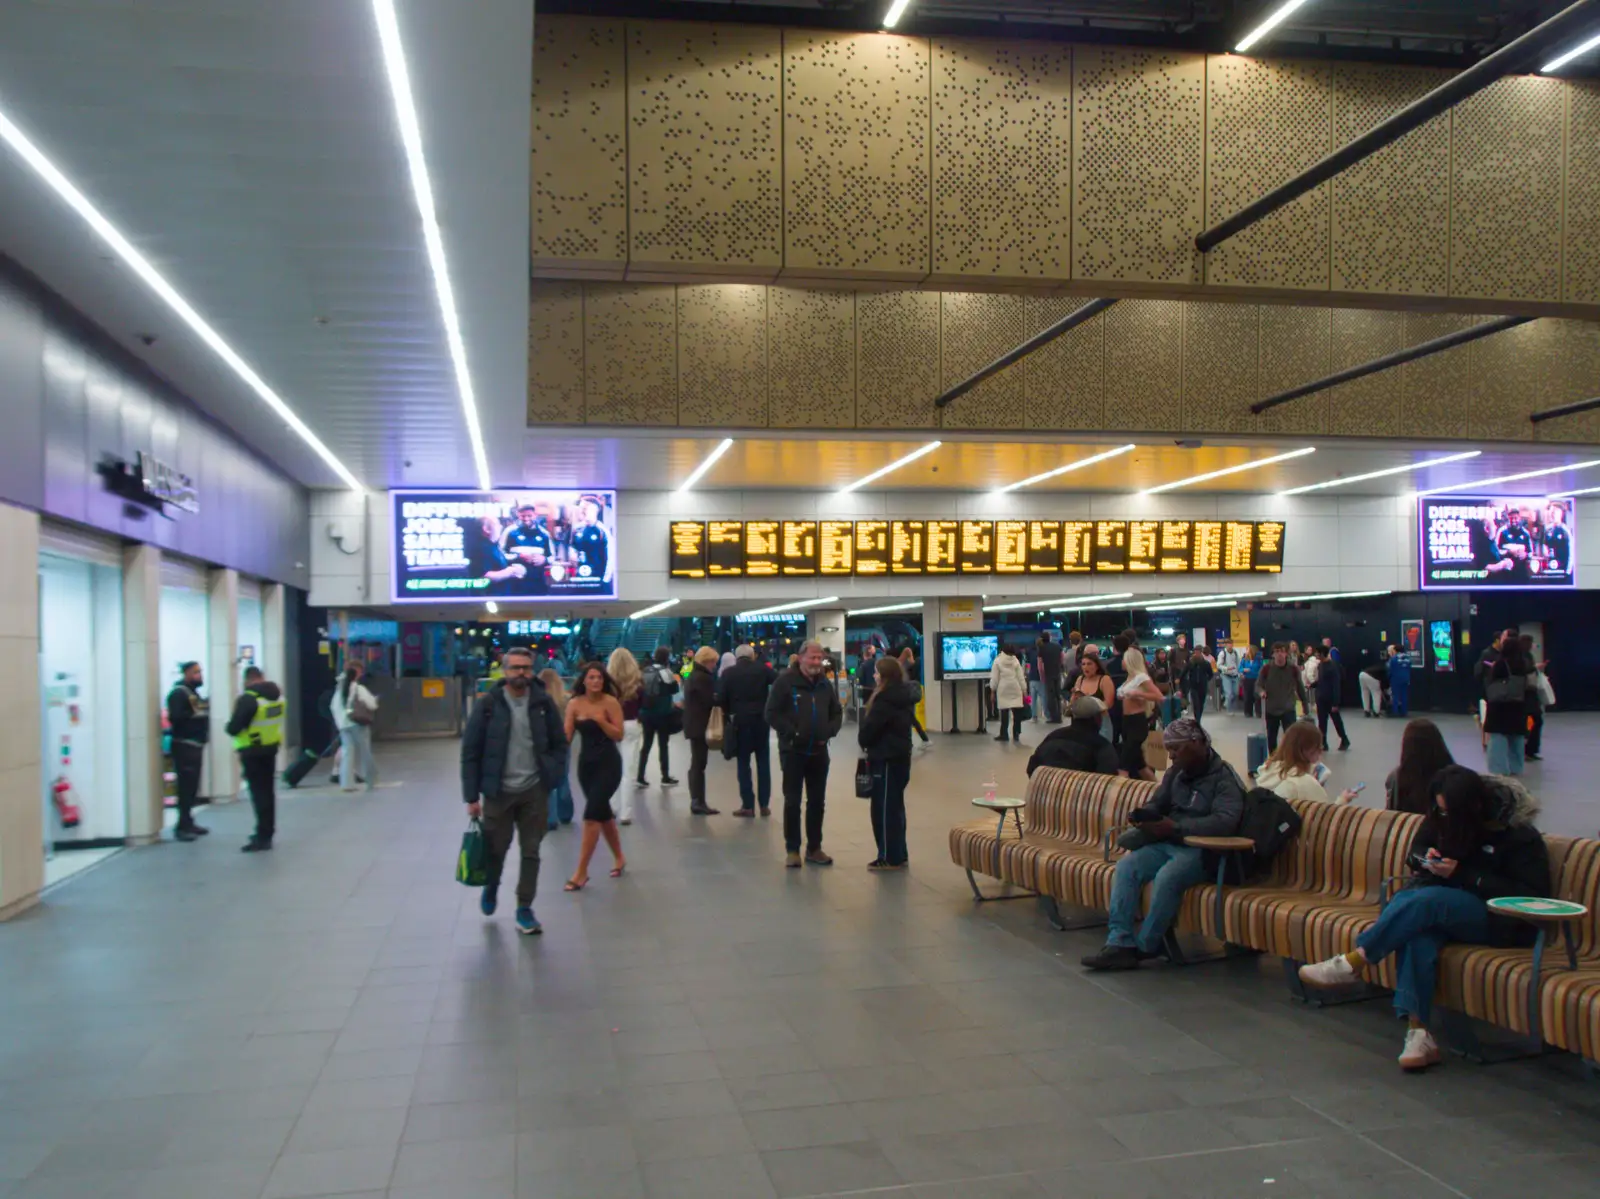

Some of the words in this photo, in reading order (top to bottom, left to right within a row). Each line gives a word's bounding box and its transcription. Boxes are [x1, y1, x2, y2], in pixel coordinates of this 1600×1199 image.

[403, 502, 511, 517] DIFFERENT
[1429, 506, 1503, 519] DIFFERENT
[403, 518, 463, 533] JOBS.
[1429, 519, 1470, 532] JOBS.
[403, 534, 463, 549] SAME
[1429, 532, 1470, 546] SAME
[403, 549, 469, 565] TEAM.
[1429, 546, 1474, 559] TEAM.
